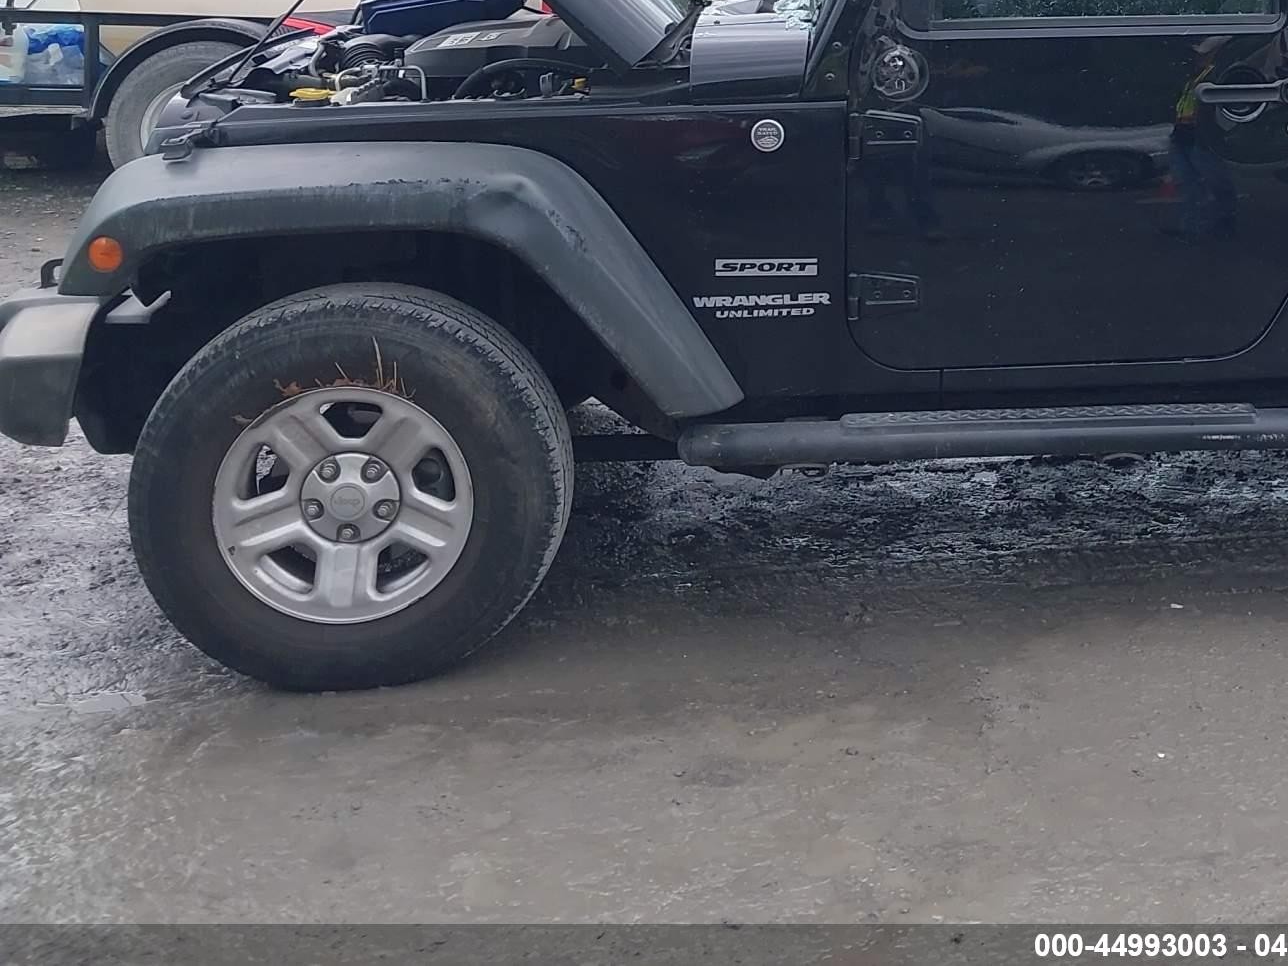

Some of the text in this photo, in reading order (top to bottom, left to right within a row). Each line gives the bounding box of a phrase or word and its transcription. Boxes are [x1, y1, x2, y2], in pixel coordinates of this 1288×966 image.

[718, 262, 812, 272] SPORT
[693, 292, 832, 308] WRANGLER
[715, 307, 815, 319] UNLIMITED
